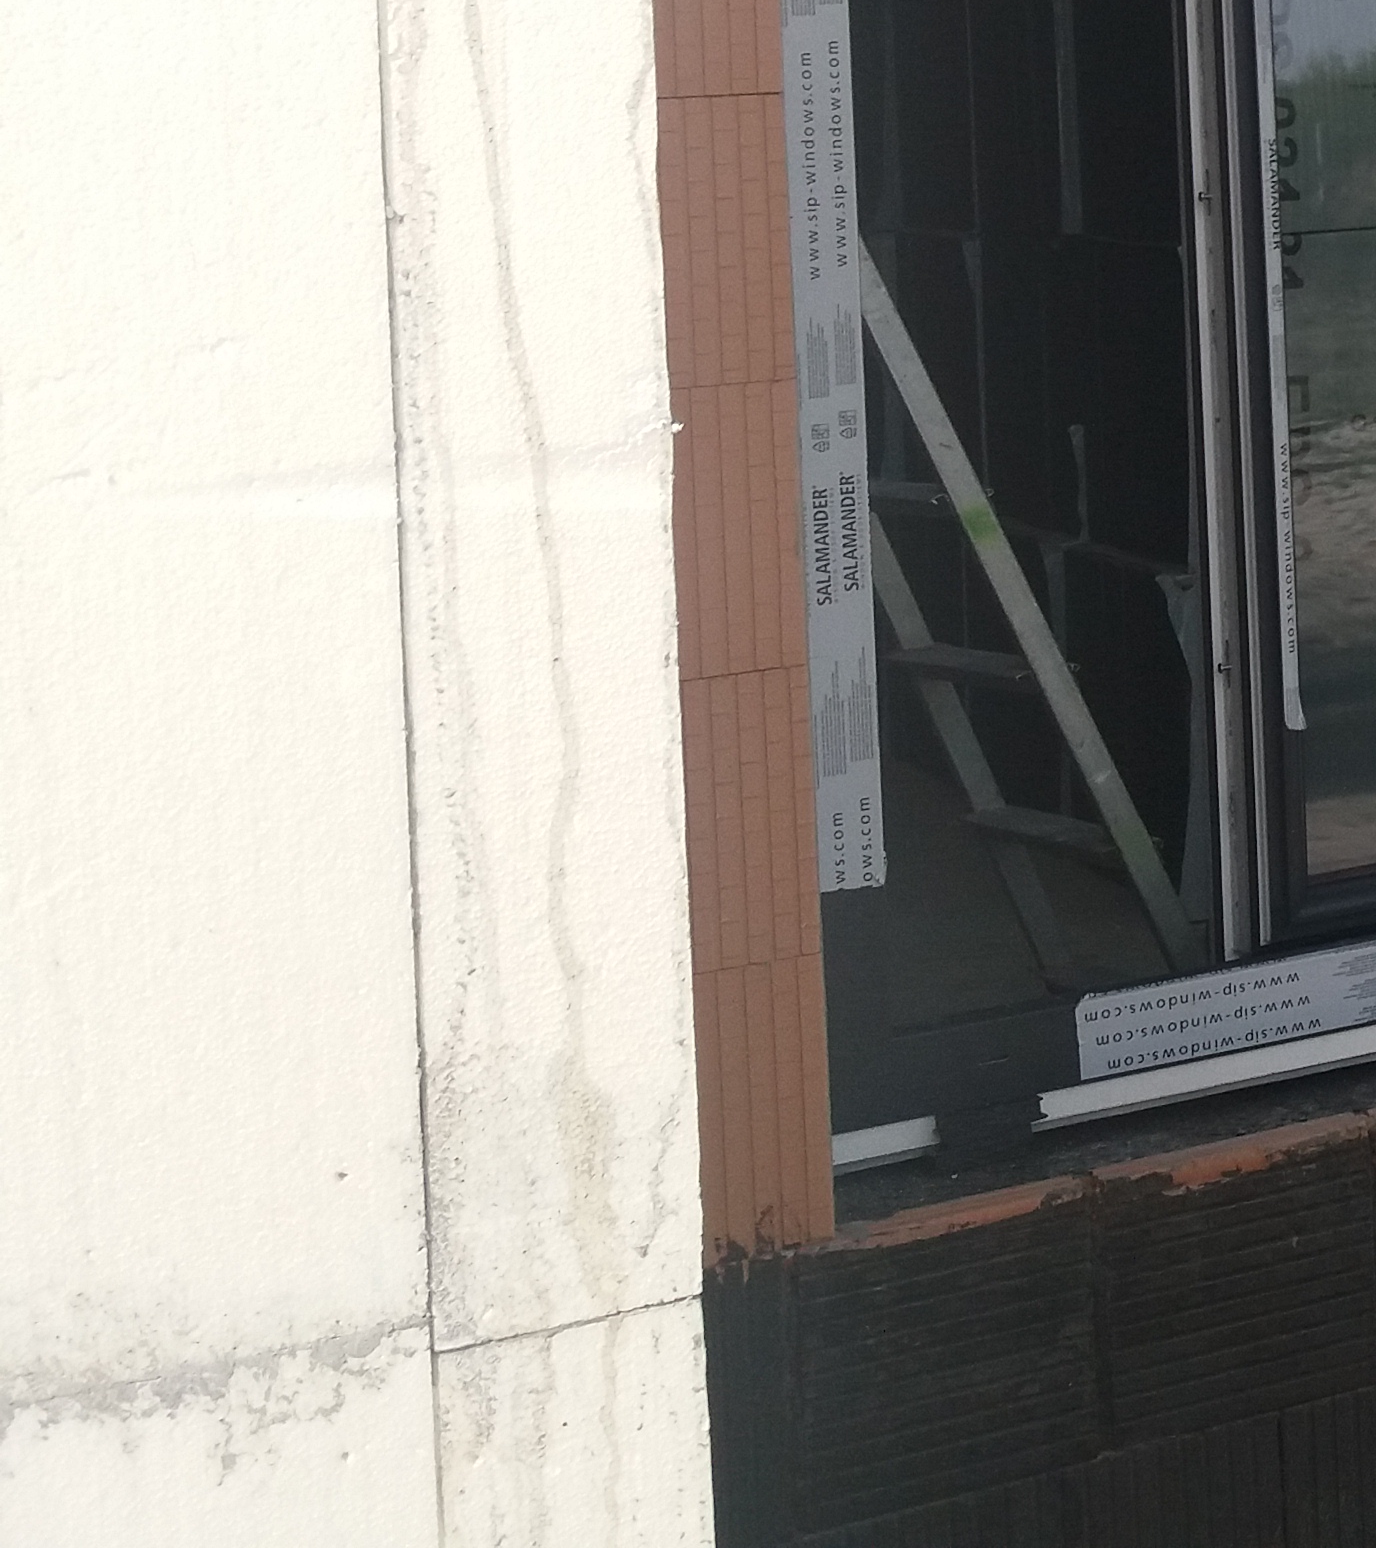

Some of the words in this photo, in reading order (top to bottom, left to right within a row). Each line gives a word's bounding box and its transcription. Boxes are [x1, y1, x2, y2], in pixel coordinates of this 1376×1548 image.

[801, 52, 820, 281] www.sip-windows.com
[828, 40, 847, 268] www.sip-windows.com
[812, 485, 833, 607] SALAMANDER
[839, 471, 860, 592] SALAMANDER
[1084, 971, 1301, 1023] www.sip-windows.com
[1095, 995, 1311, 1047] www.sip-windows.com
[1107, 1018, 1321, 1071] www.sip-windows.com
